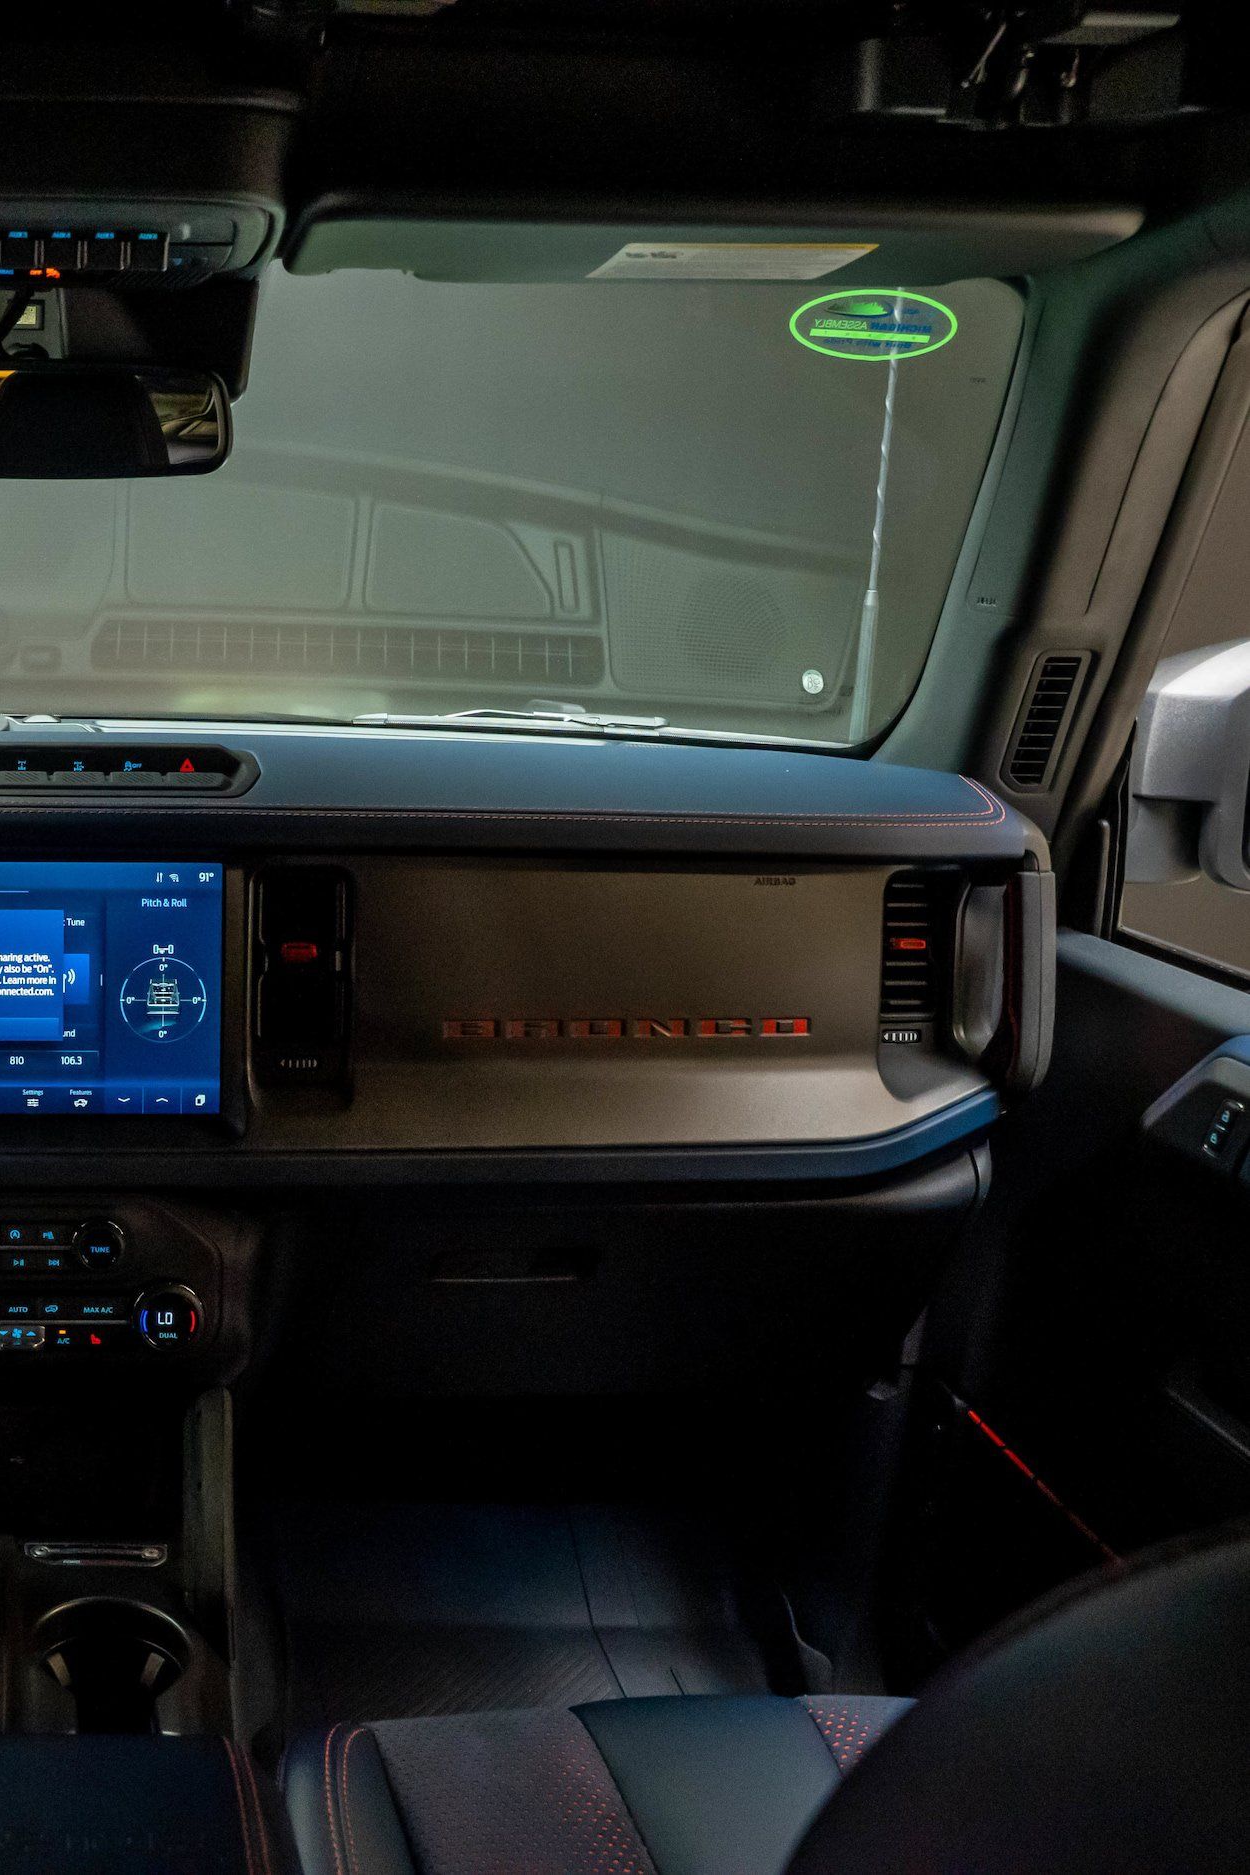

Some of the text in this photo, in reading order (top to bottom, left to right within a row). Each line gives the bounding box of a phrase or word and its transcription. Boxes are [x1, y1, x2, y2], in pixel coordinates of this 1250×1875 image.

[199, 872, 215, 883] 91°
[141, 898, 187, 908] Pitch & Roll
[66, 917, 85, 927] Tune
[24, 953, 50, 962] active.
[3, 964, 21, 973] also
[22, 964, 32, 973] be
[2, 975, 26, 985] Learn
[26, 977, 48, 985] more
[442, 1015, 812, 1039] BRONCO
[9, 1055, 25, 1065] 810
[60, 1055, 83, 1065] 106.3
[22, 1088, 44, 1097] Settings
[69, 1088, 93, 1096] Features
[90, 1246, 111, 1254] TUNE
[100, 1305, 114, 1314] A/C
[56, 1336, 71, 1345] A/C
[158, 1332, 178, 1340] DUAL
